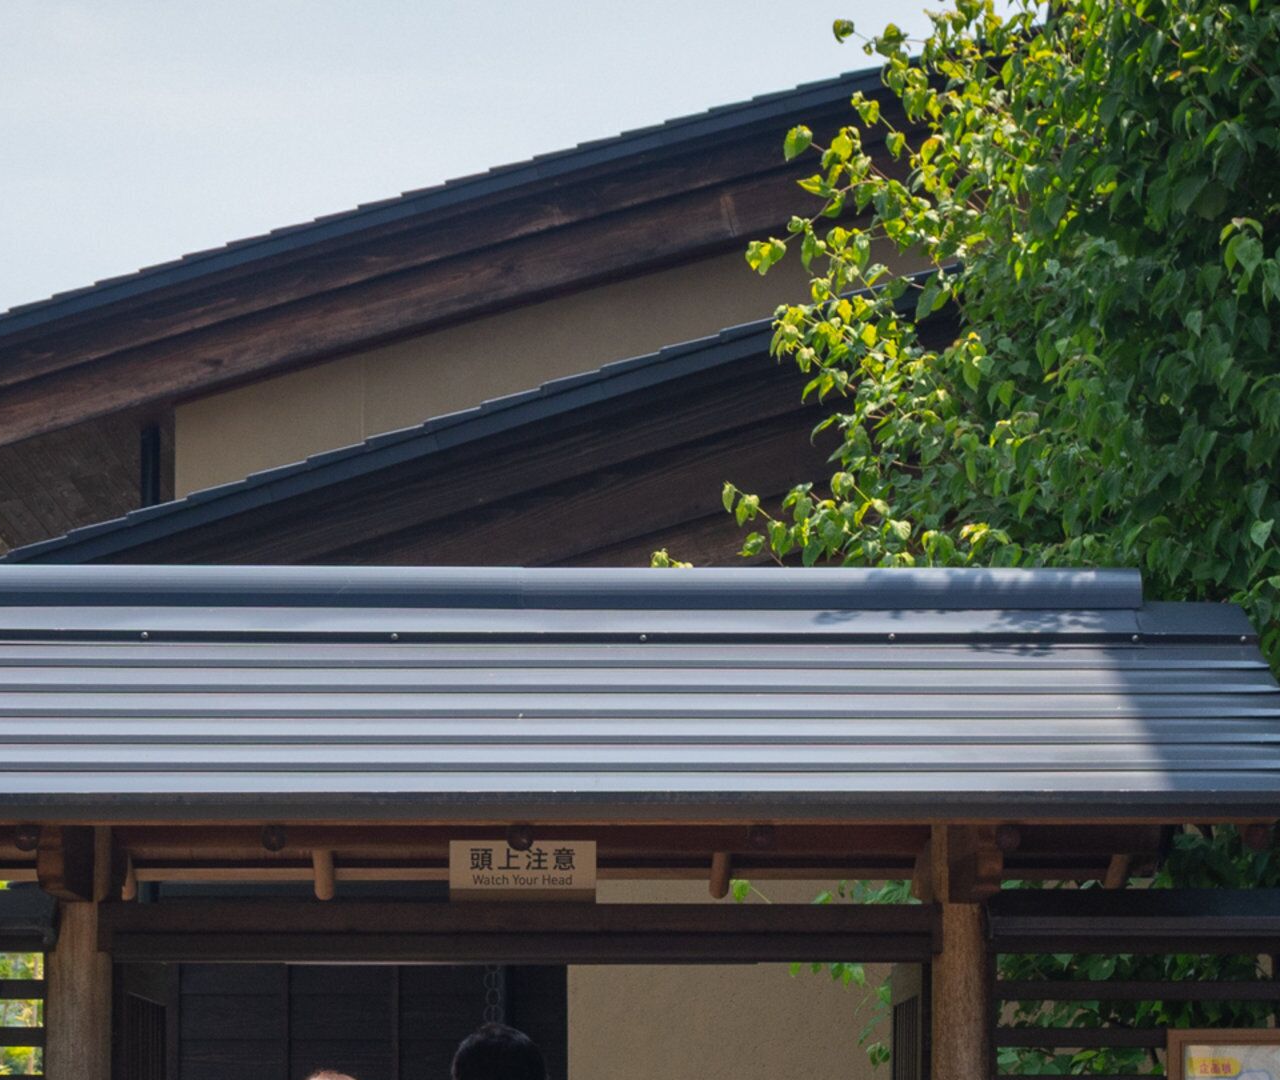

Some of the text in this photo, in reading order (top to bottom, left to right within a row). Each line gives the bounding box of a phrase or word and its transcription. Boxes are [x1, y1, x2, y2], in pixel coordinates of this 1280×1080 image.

[470, 848, 575, 871] 頭上注意
[472, 874, 573, 886] Watch Your Head
